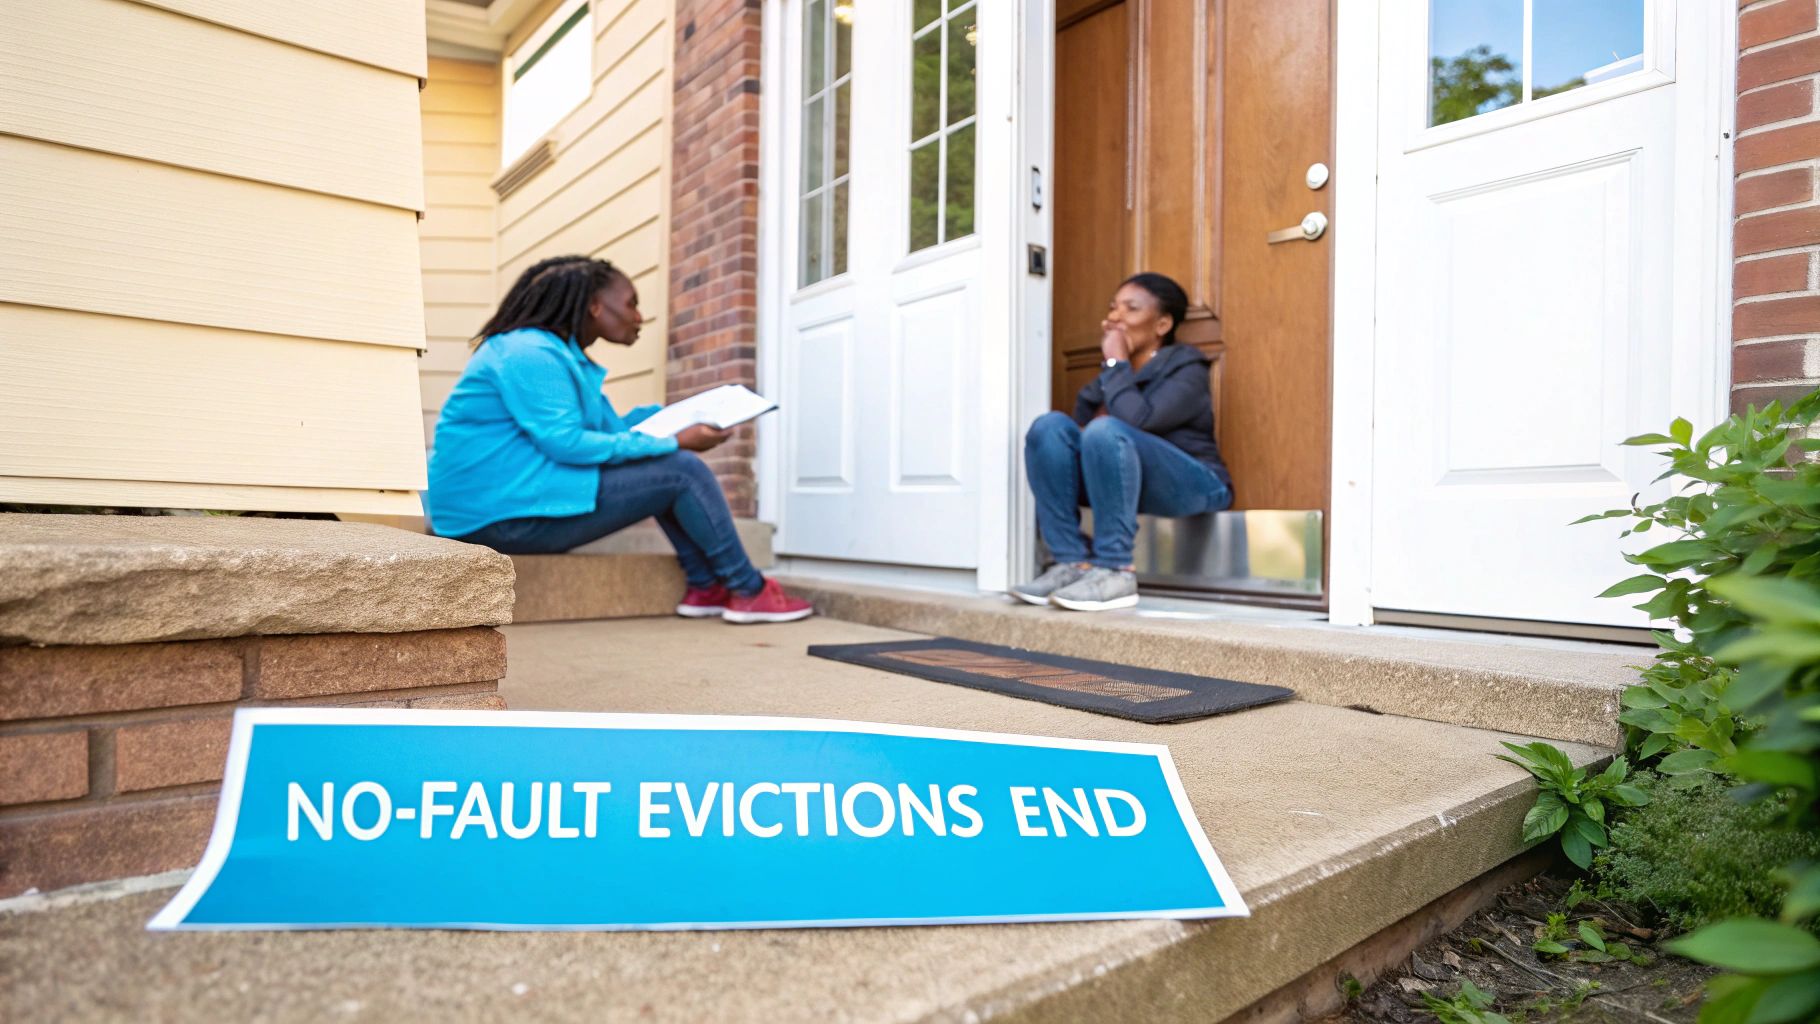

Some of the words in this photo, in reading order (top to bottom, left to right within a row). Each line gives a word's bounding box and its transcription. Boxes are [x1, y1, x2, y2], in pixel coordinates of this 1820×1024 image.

[286, 781, 611, 841] NO-FAULT
[638, 781, 984, 838] EVICTIONS
[1009, 786, 1147, 837] END
